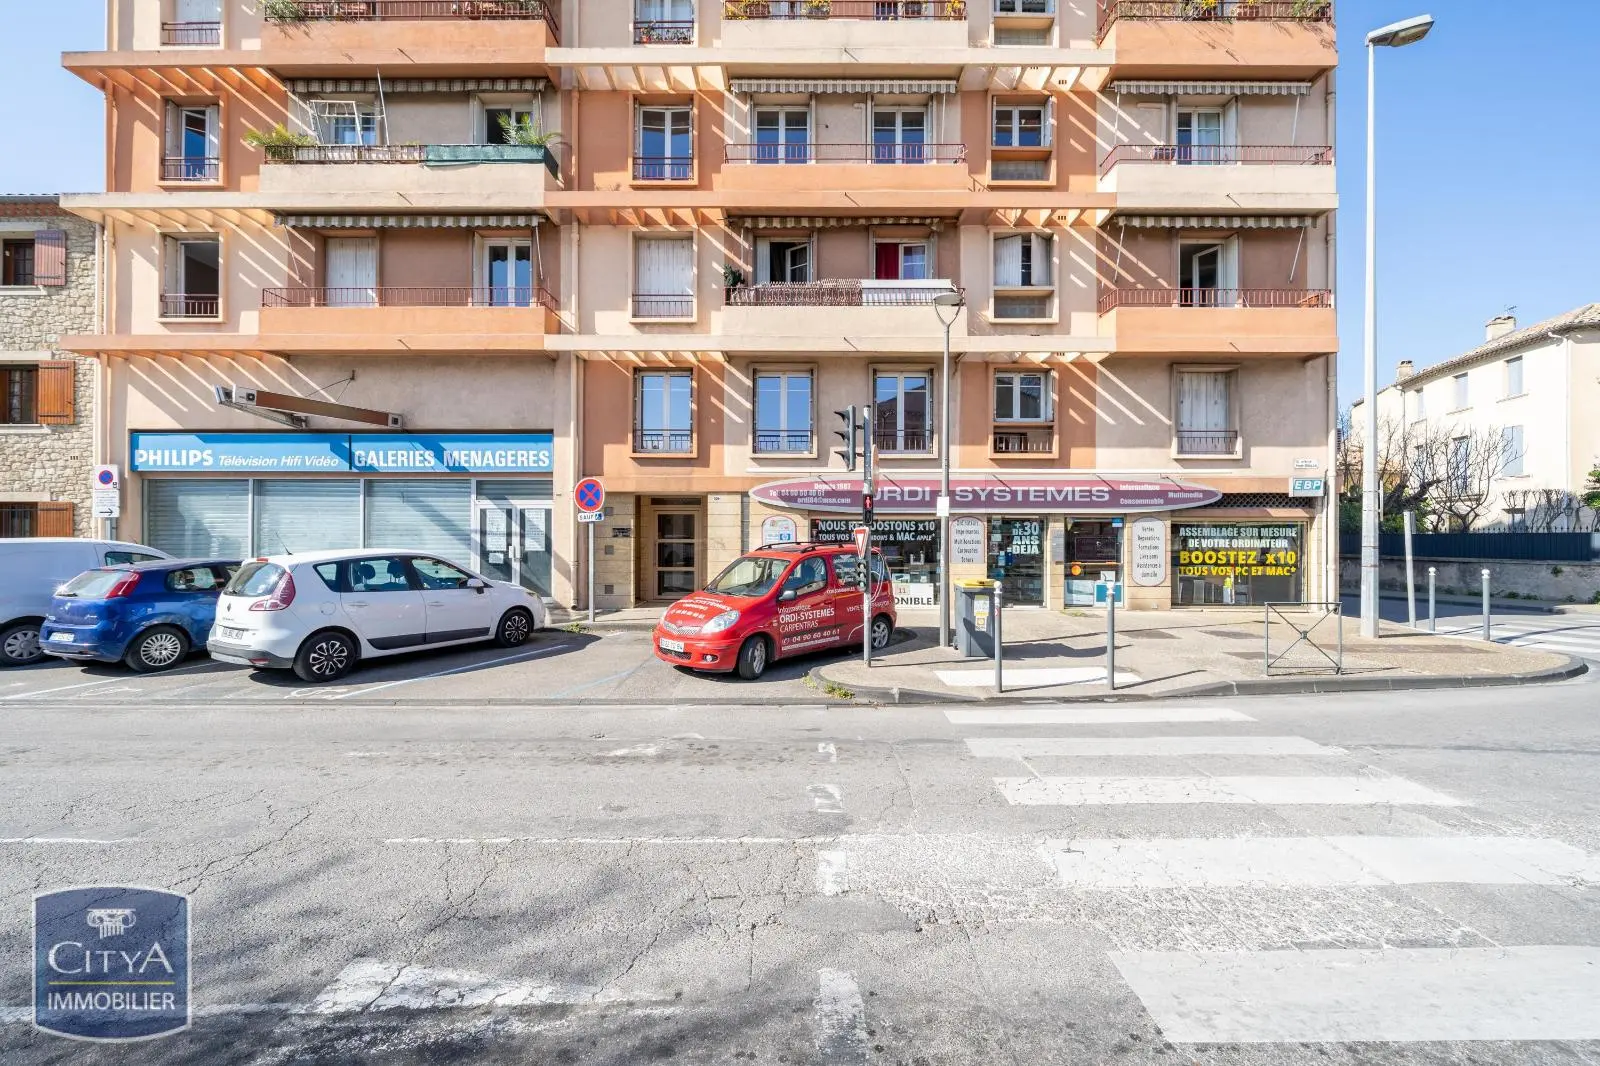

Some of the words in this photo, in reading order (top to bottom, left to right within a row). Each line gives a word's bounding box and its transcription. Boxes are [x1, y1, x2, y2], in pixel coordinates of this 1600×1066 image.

[135, 449, 213, 466] PHILIPS
[218, 455, 277, 466] Télévision
[281, 455, 301, 466] Hifi
[305, 455, 339, 467] Vidéo
[354, 450, 435, 467] GALERIES
[443, 450, 550, 467] MENAGERES
[1294, 480, 1321, 490] EBP
[955, 487, 1110, 501] SYSTEMES
[818, 521, 845, 531] NOUS
[918, 521, 935, 531] x10
[1023, 522, 1040, 535] 30
[818, 533, 835, 541] TOUS
[836, 533, 850, 541] VOS
[896, 532, 915, 541] MAC
[1179, 527, 1239, 537] ASSEMBLAGE
[1240, 527, 1258, 537] SUR
[1261, 527, 1297, 537] MESURE
[1012, 535, 1040, 545] ANS
[1188, 539, 1200, 548] DE
[1201, 539, 1231, 548] VOTRE
[1232, 539, 1289, 548] ORDINATEUR
[1012, 545, 1040, 554] DEJA
[1179, 551, 1257, 564] BOOSTEZ
[1265, 551, 1296, 564] x10
[1179, 566, 1208, 576] TOUS
[1210, 566, 1233, 576] VOS
[1235, 566, 1248, 576] PC
[1251, 566, 1264, 576] ET
[895, 597, 933, 606] ONIBLE
[779, 608, 835, 624] ORDI-SYSTEMES
[780, 620, 819, 633] CARPENTRAS
